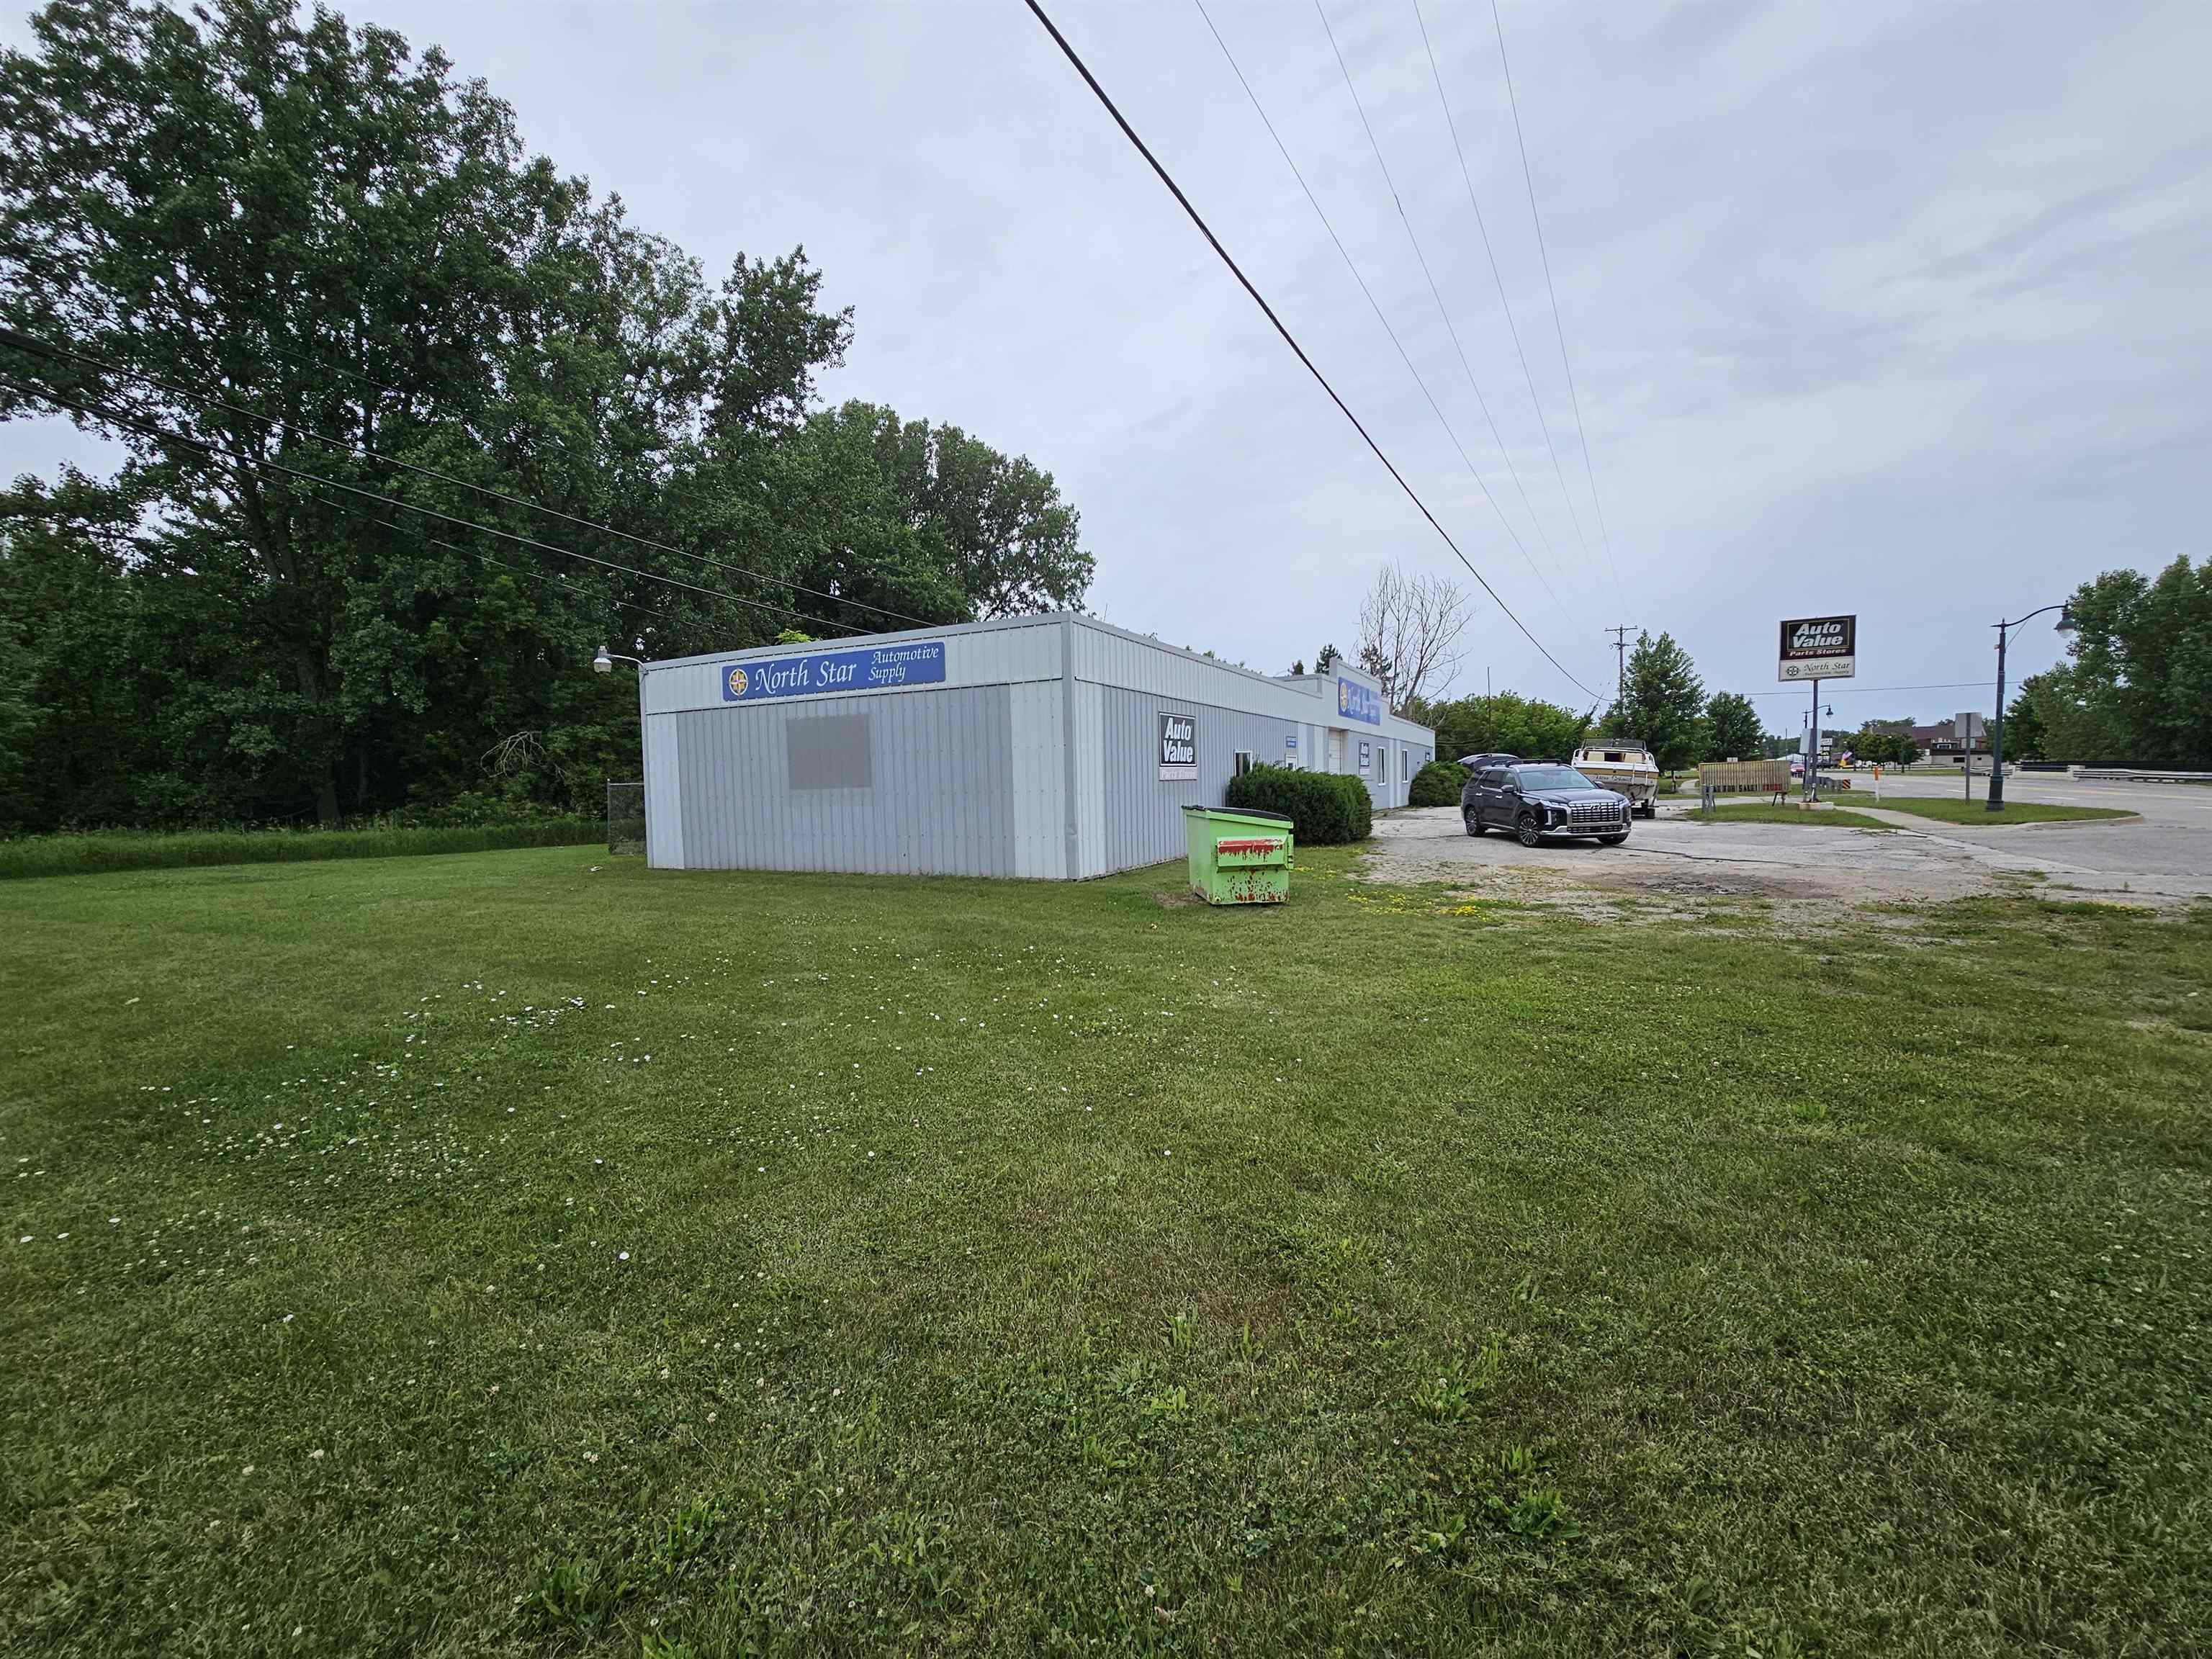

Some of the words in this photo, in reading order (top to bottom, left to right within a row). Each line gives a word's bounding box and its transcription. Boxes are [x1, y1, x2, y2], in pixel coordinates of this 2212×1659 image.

[1795, 622, 1841, 636] Auto
[1793, 635, 1843, 648] Value
[871, 646, 939, 664] Automotive
[755, 659, 809, 693] North
[817, 661, 857, 686] Star
[868, 662, 906, 683] Supply
[1164, 717, 1192, 741] Auto
[1163, 739, 1193, 763] Value
